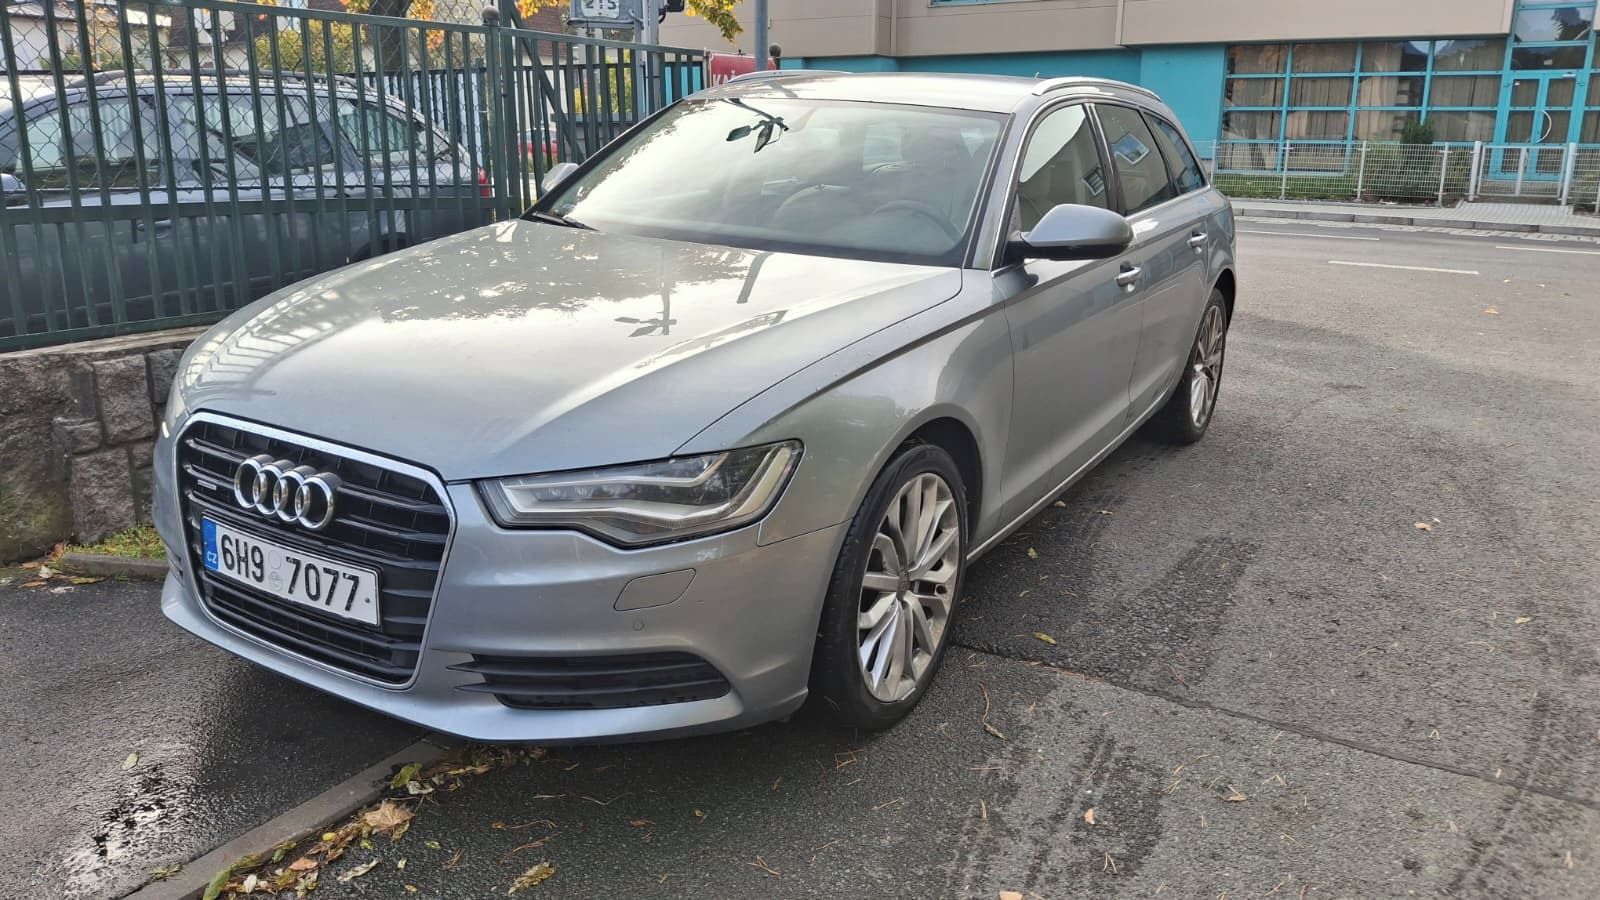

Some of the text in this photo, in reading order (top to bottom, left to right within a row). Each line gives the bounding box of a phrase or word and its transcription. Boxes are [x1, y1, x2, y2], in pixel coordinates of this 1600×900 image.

[206, 551, 217, 564] CZ
[221, 534, 359, 611] 6H9 7077
